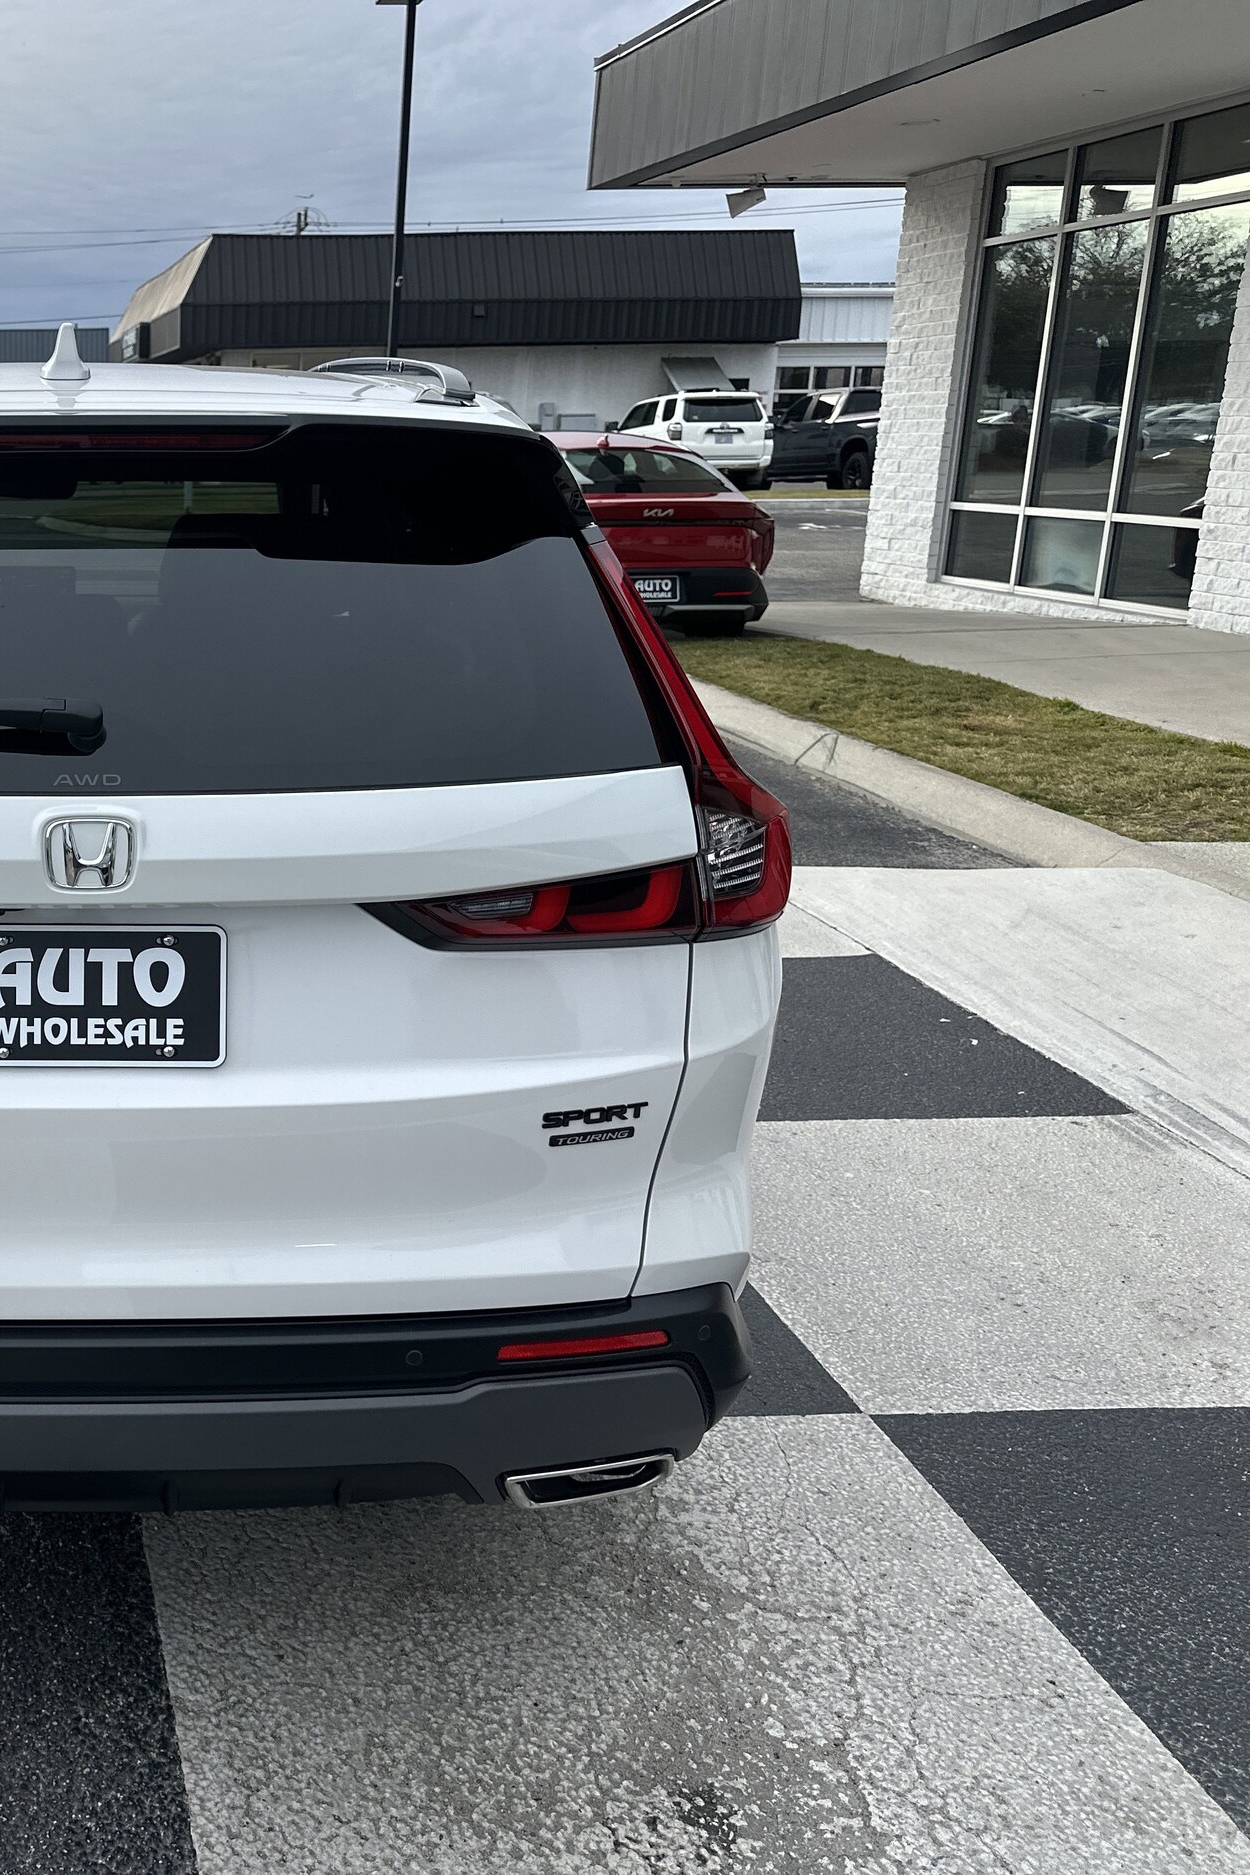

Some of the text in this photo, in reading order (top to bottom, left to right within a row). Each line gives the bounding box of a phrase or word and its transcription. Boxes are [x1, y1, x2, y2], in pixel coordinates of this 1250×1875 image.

[634, 579, 672, 592] AUTO
[53, 774, 121, 786] AWD
[541, 1101, 649, 1129] SPORT
[556, 1130, 630, 1146] TOURING
